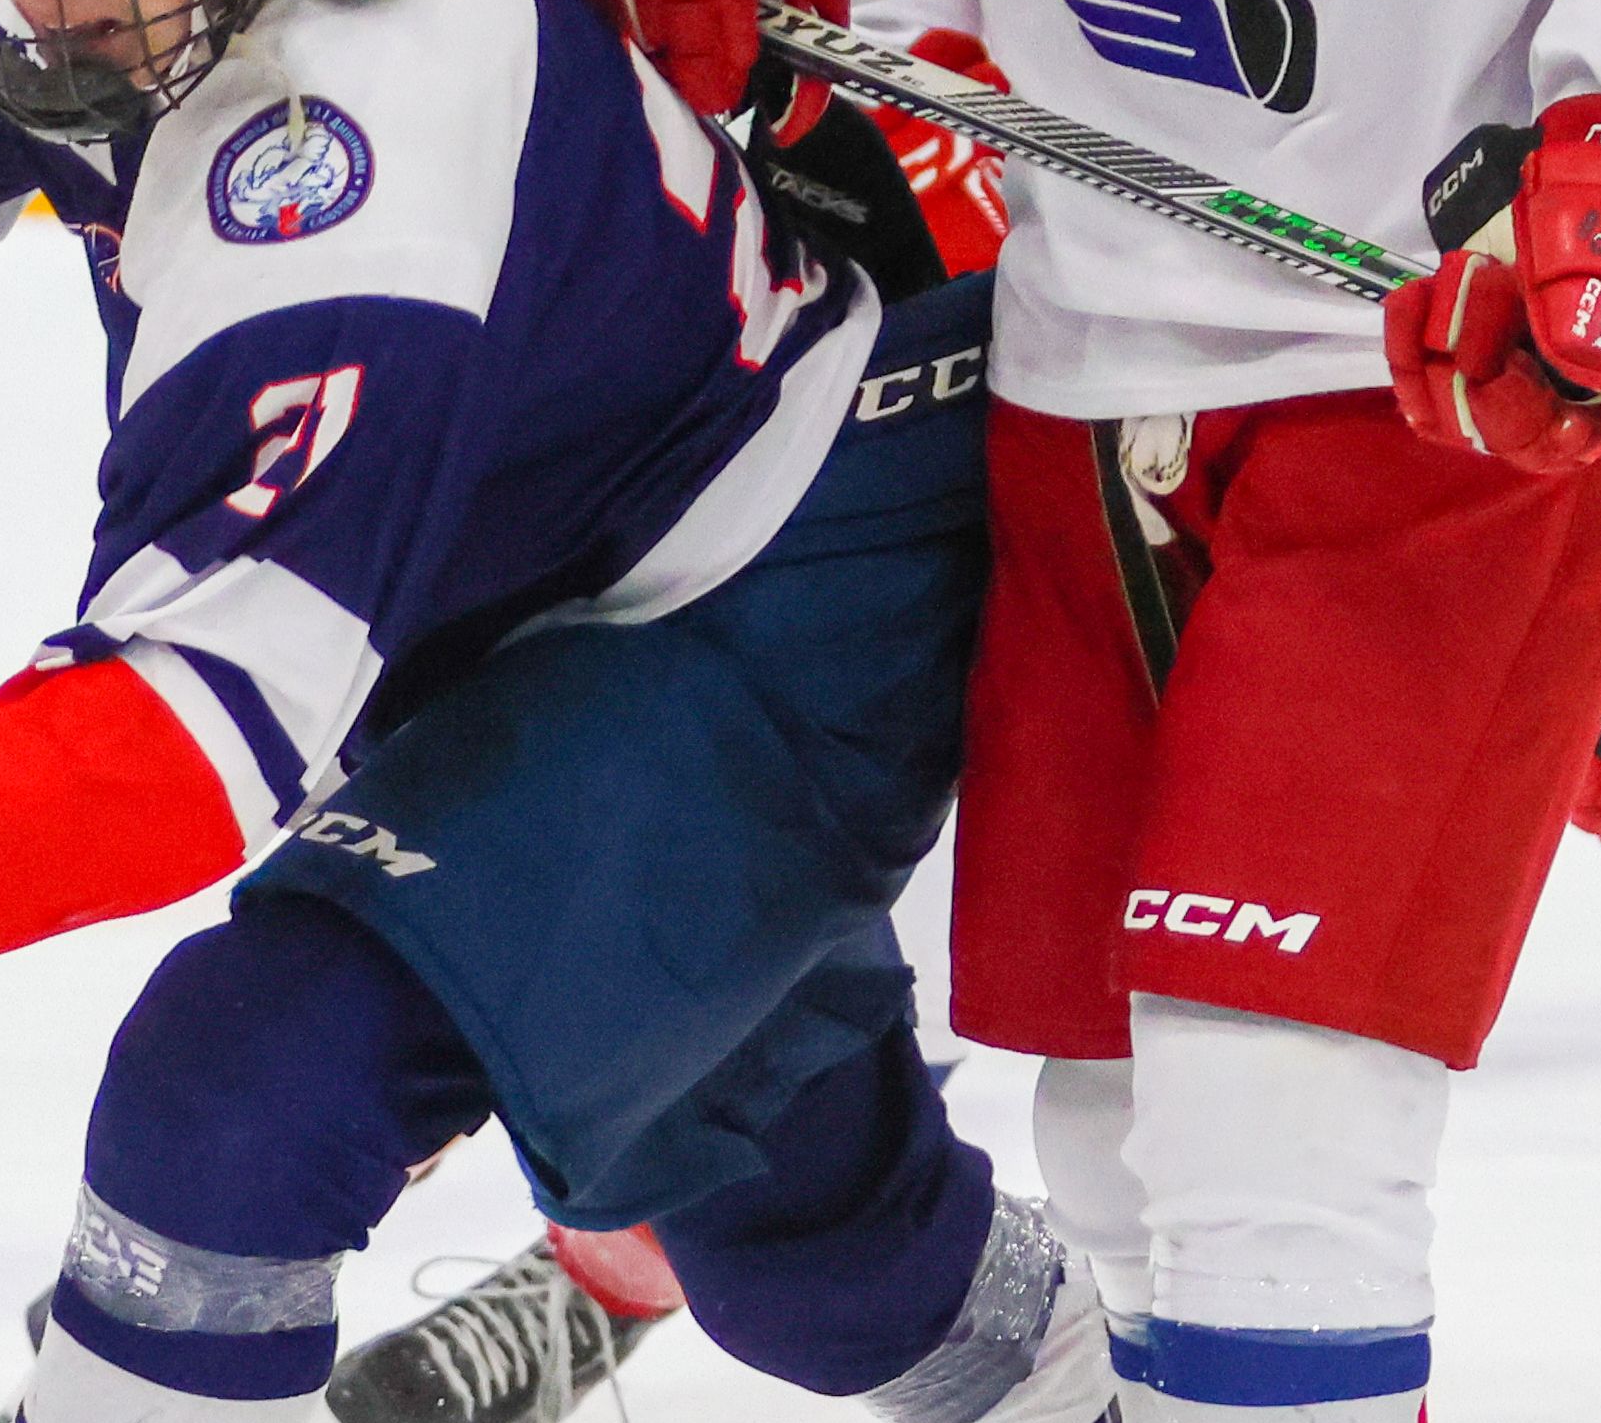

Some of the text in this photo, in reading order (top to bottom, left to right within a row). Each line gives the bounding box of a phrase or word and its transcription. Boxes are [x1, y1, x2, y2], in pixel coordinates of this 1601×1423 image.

[1429, 147, 1485, 217] CCM
[300, 811, 438, 877] CM
[1123, 888, 1321, 954] CCM
